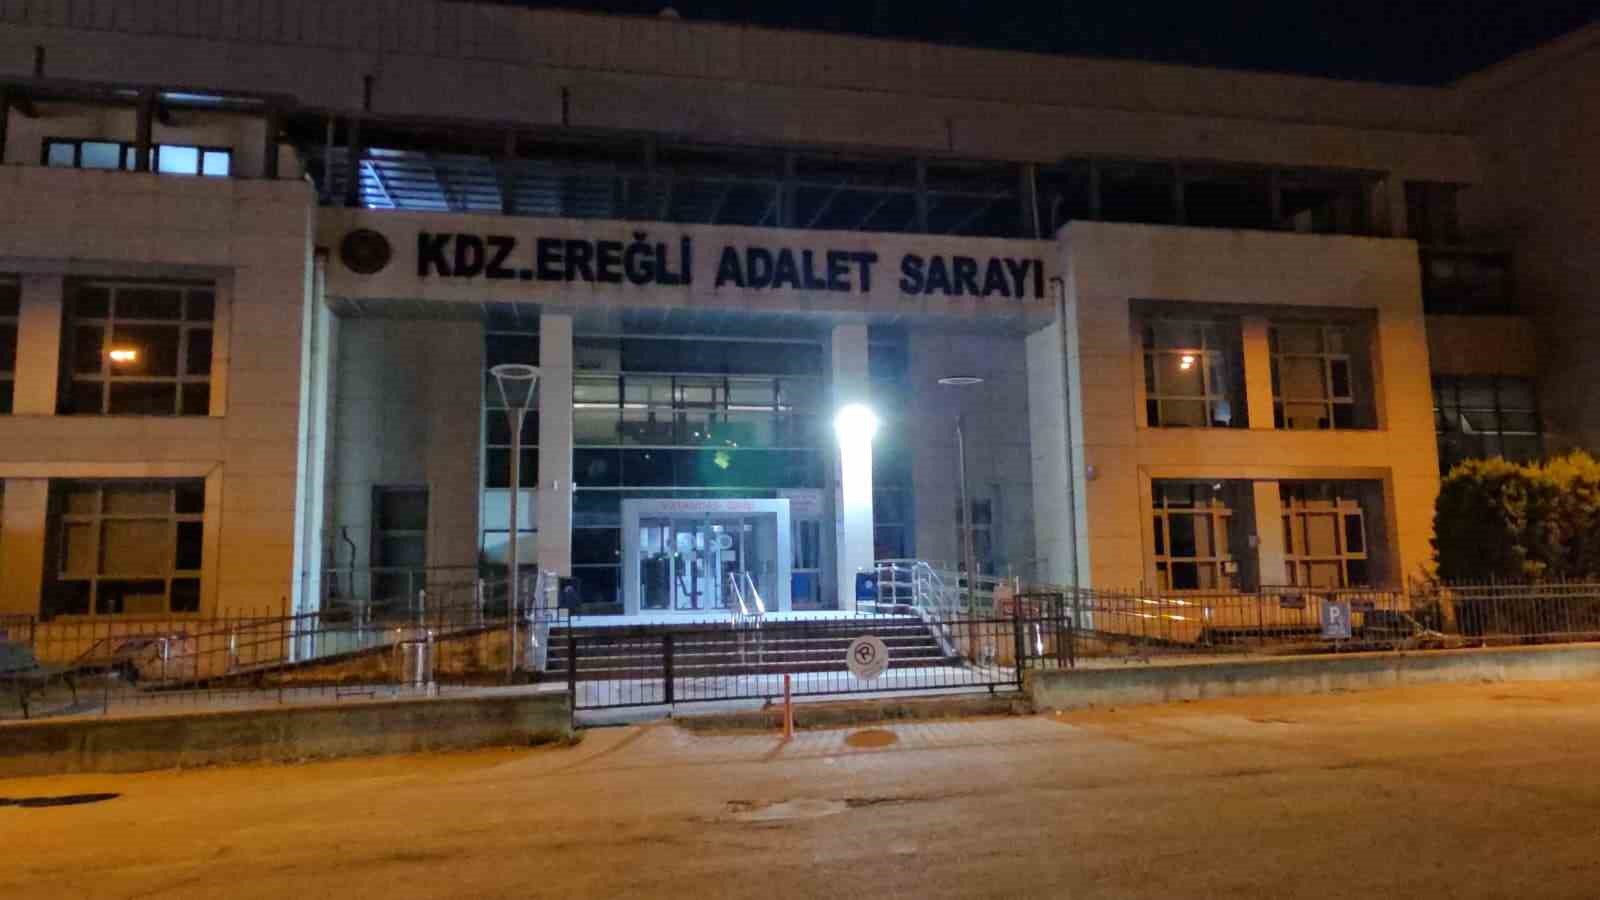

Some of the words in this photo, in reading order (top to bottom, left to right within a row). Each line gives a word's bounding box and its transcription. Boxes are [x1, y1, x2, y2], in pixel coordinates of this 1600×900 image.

[417, 231, 692, 286] KDZ.EREĞLİ
[714, 246, 878, 293] ADALET
[901, 253, 1045, 299] SARAYI
